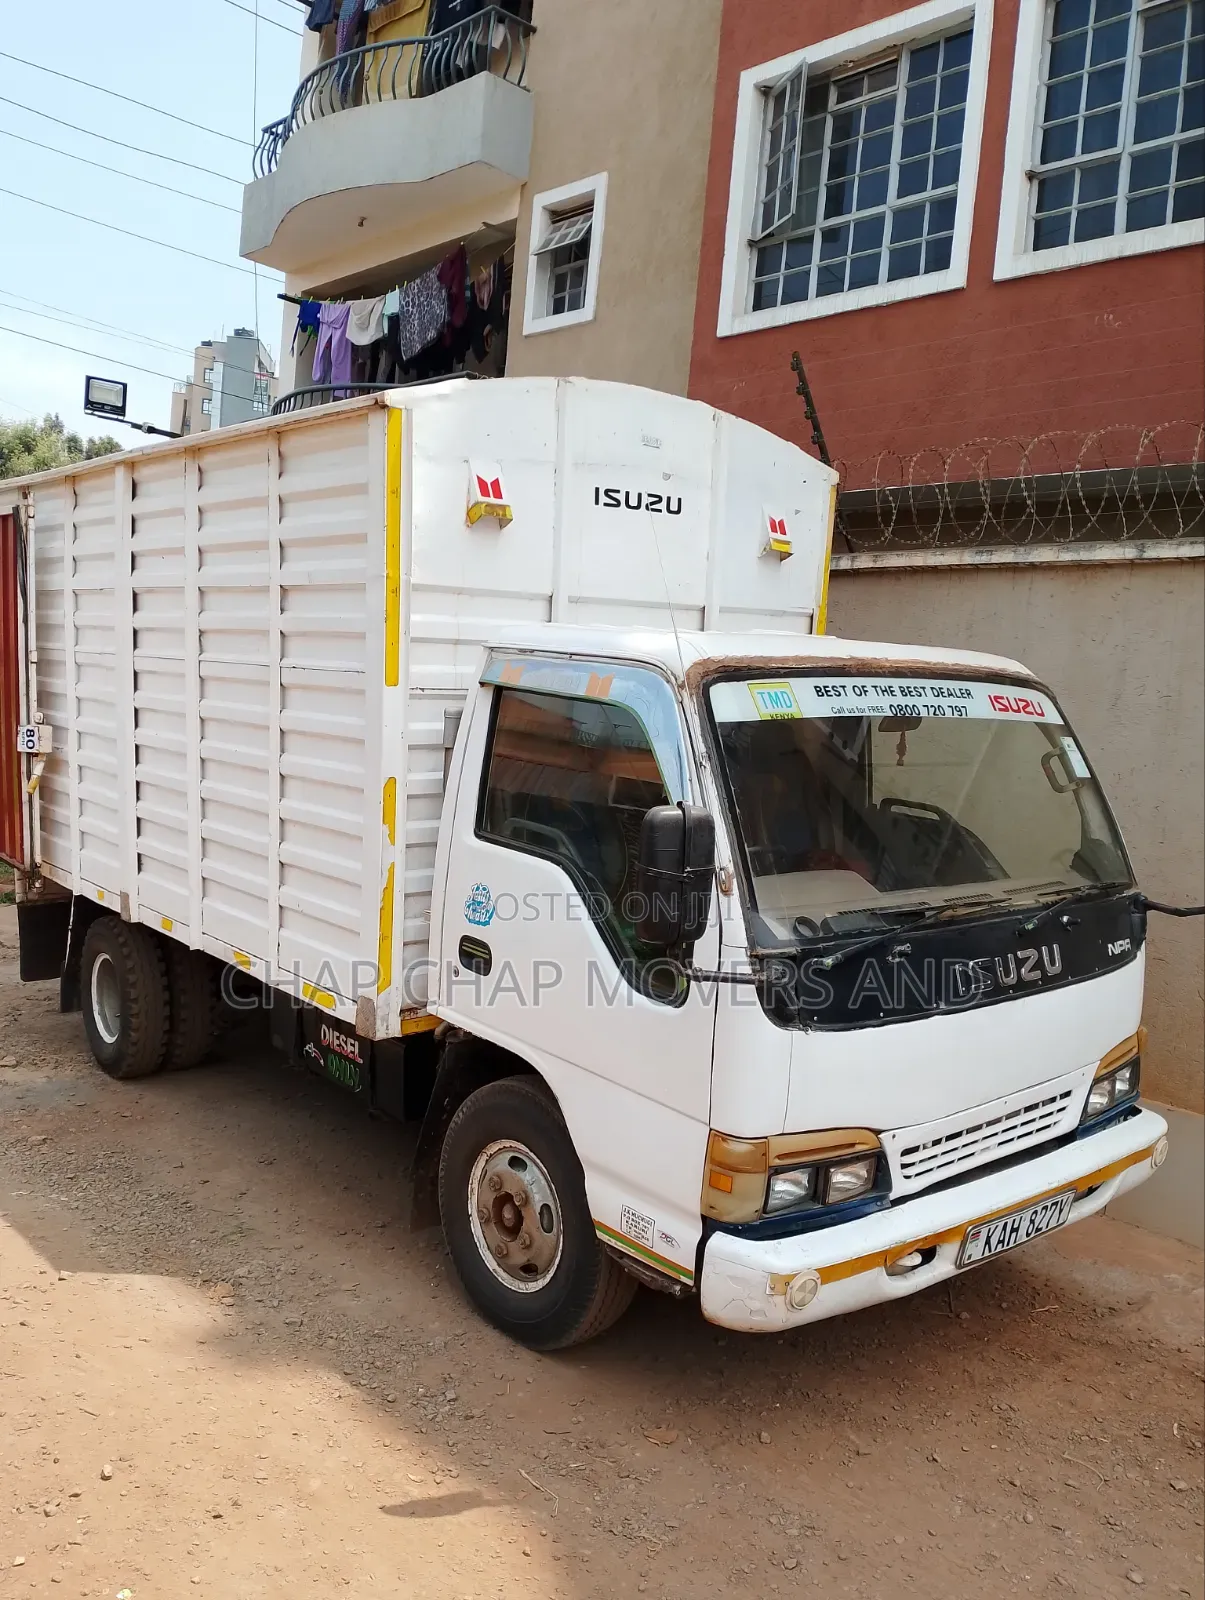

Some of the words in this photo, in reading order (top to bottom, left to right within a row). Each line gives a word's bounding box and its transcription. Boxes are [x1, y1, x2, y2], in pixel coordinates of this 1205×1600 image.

[595, 487, 682, 515] ISUZU
[757, 690, 793, 710] TMD
[813, 685, 849, 698] BEST
[852, 686, 869, 698] OF
[871, 685, 897, 697] THE
[900, 686, 929, 698] BEST
[931, 686, 974, 700] DEALER
[769, 712, 795, 720] KENYA
[831, 706, 846, 715] Call
[856, 705, 867, 714] for
[889, 704, 921, 717] 0800
[922, 704, 946, 717] 720
[949, 705, 969, 718] 797
[988, 694, 1046, 718] ISUZU
[26, 728, 35, 750] 80
[954, 942, 1063, 997] ISUZU
[321, 1024, 363, 1064] DIESEL
[981, 1215, 1023, 1257] KAH
[1025, 1196, 1071, 1239] 827Y
